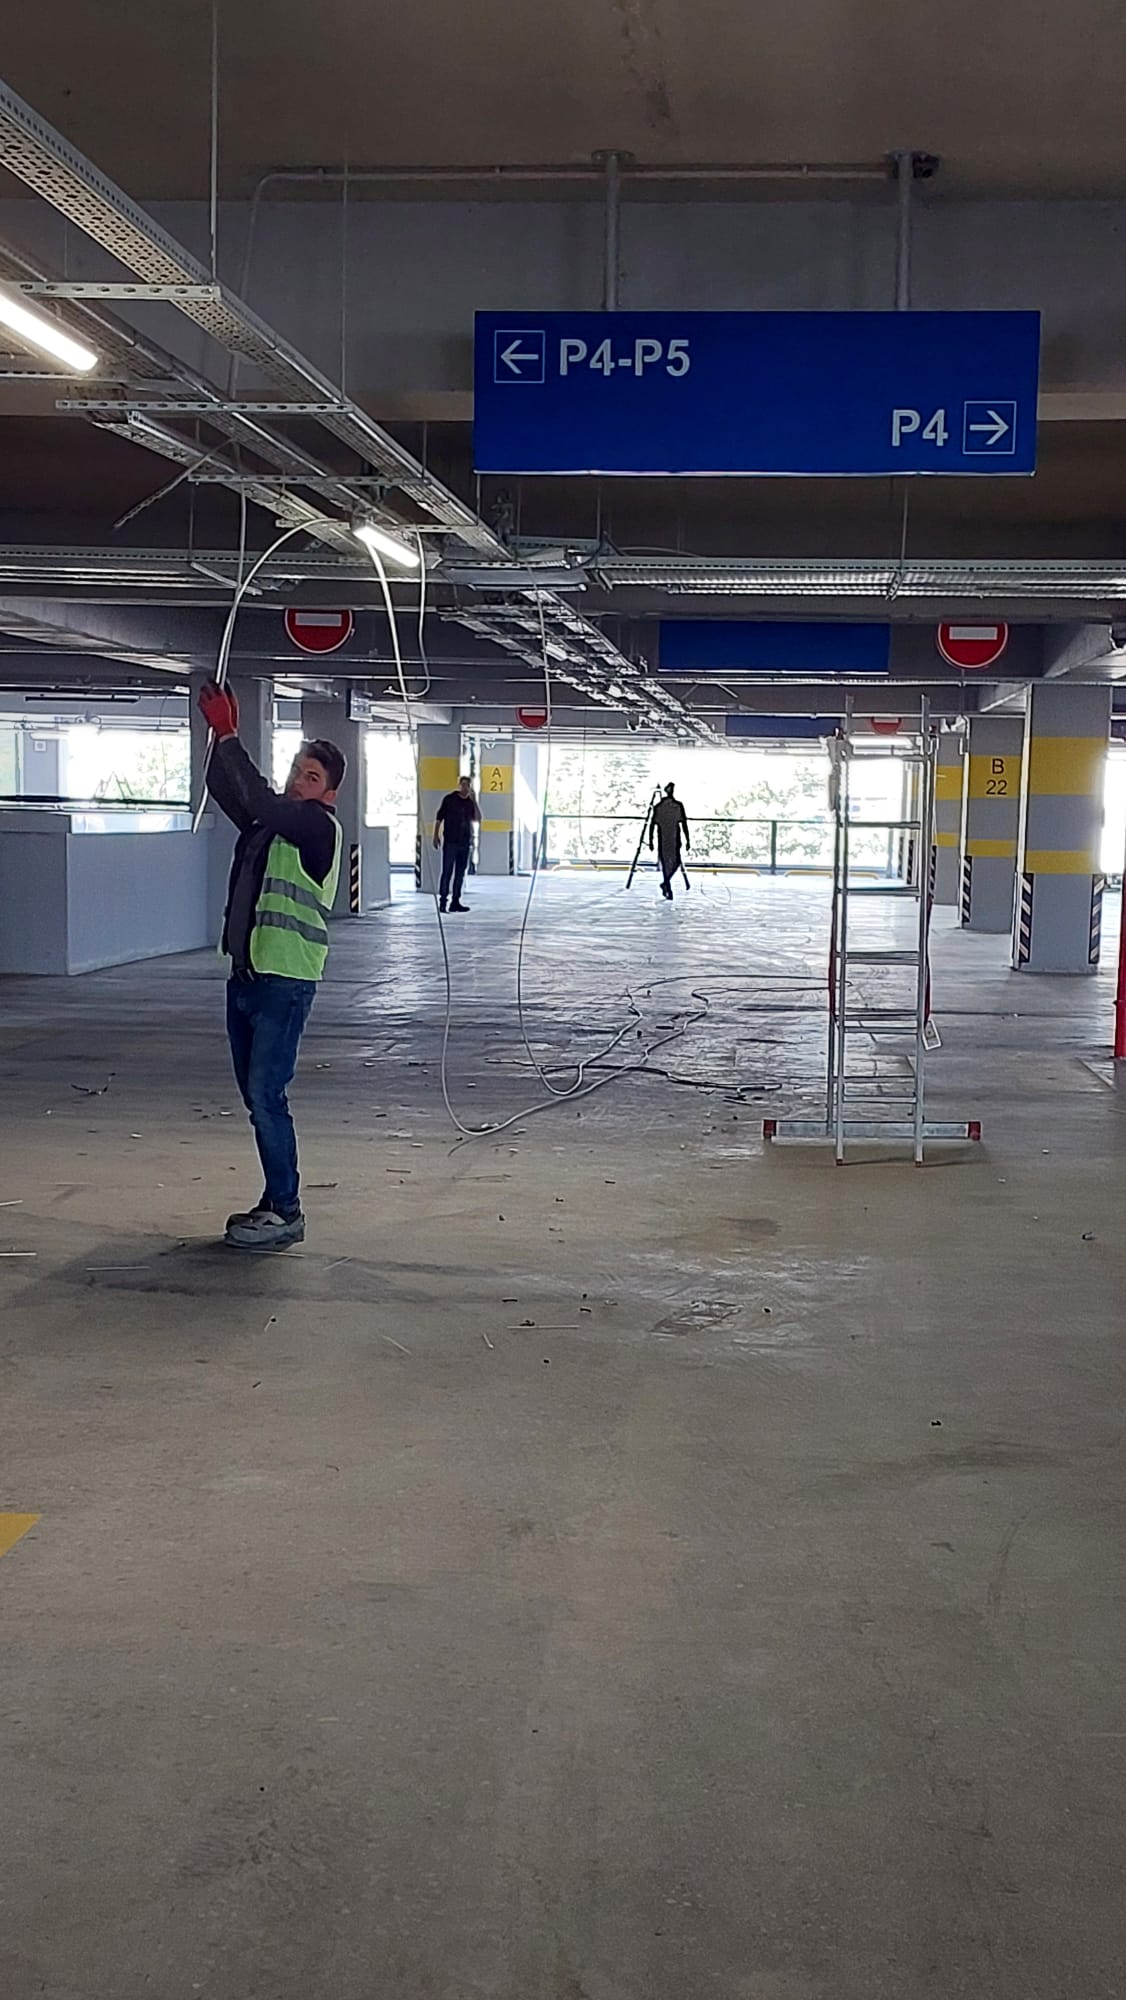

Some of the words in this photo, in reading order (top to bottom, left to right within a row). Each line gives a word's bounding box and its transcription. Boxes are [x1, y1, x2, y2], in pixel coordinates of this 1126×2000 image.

[560, 339, 690, 376] P4-P5
[892, 409, 949, 446] P4
[492, 767, 501, 778] A
[992, 758, 1004, 774] B
[490, 780, 503, 791] 21
[986, 780, 1007, 795] 22
